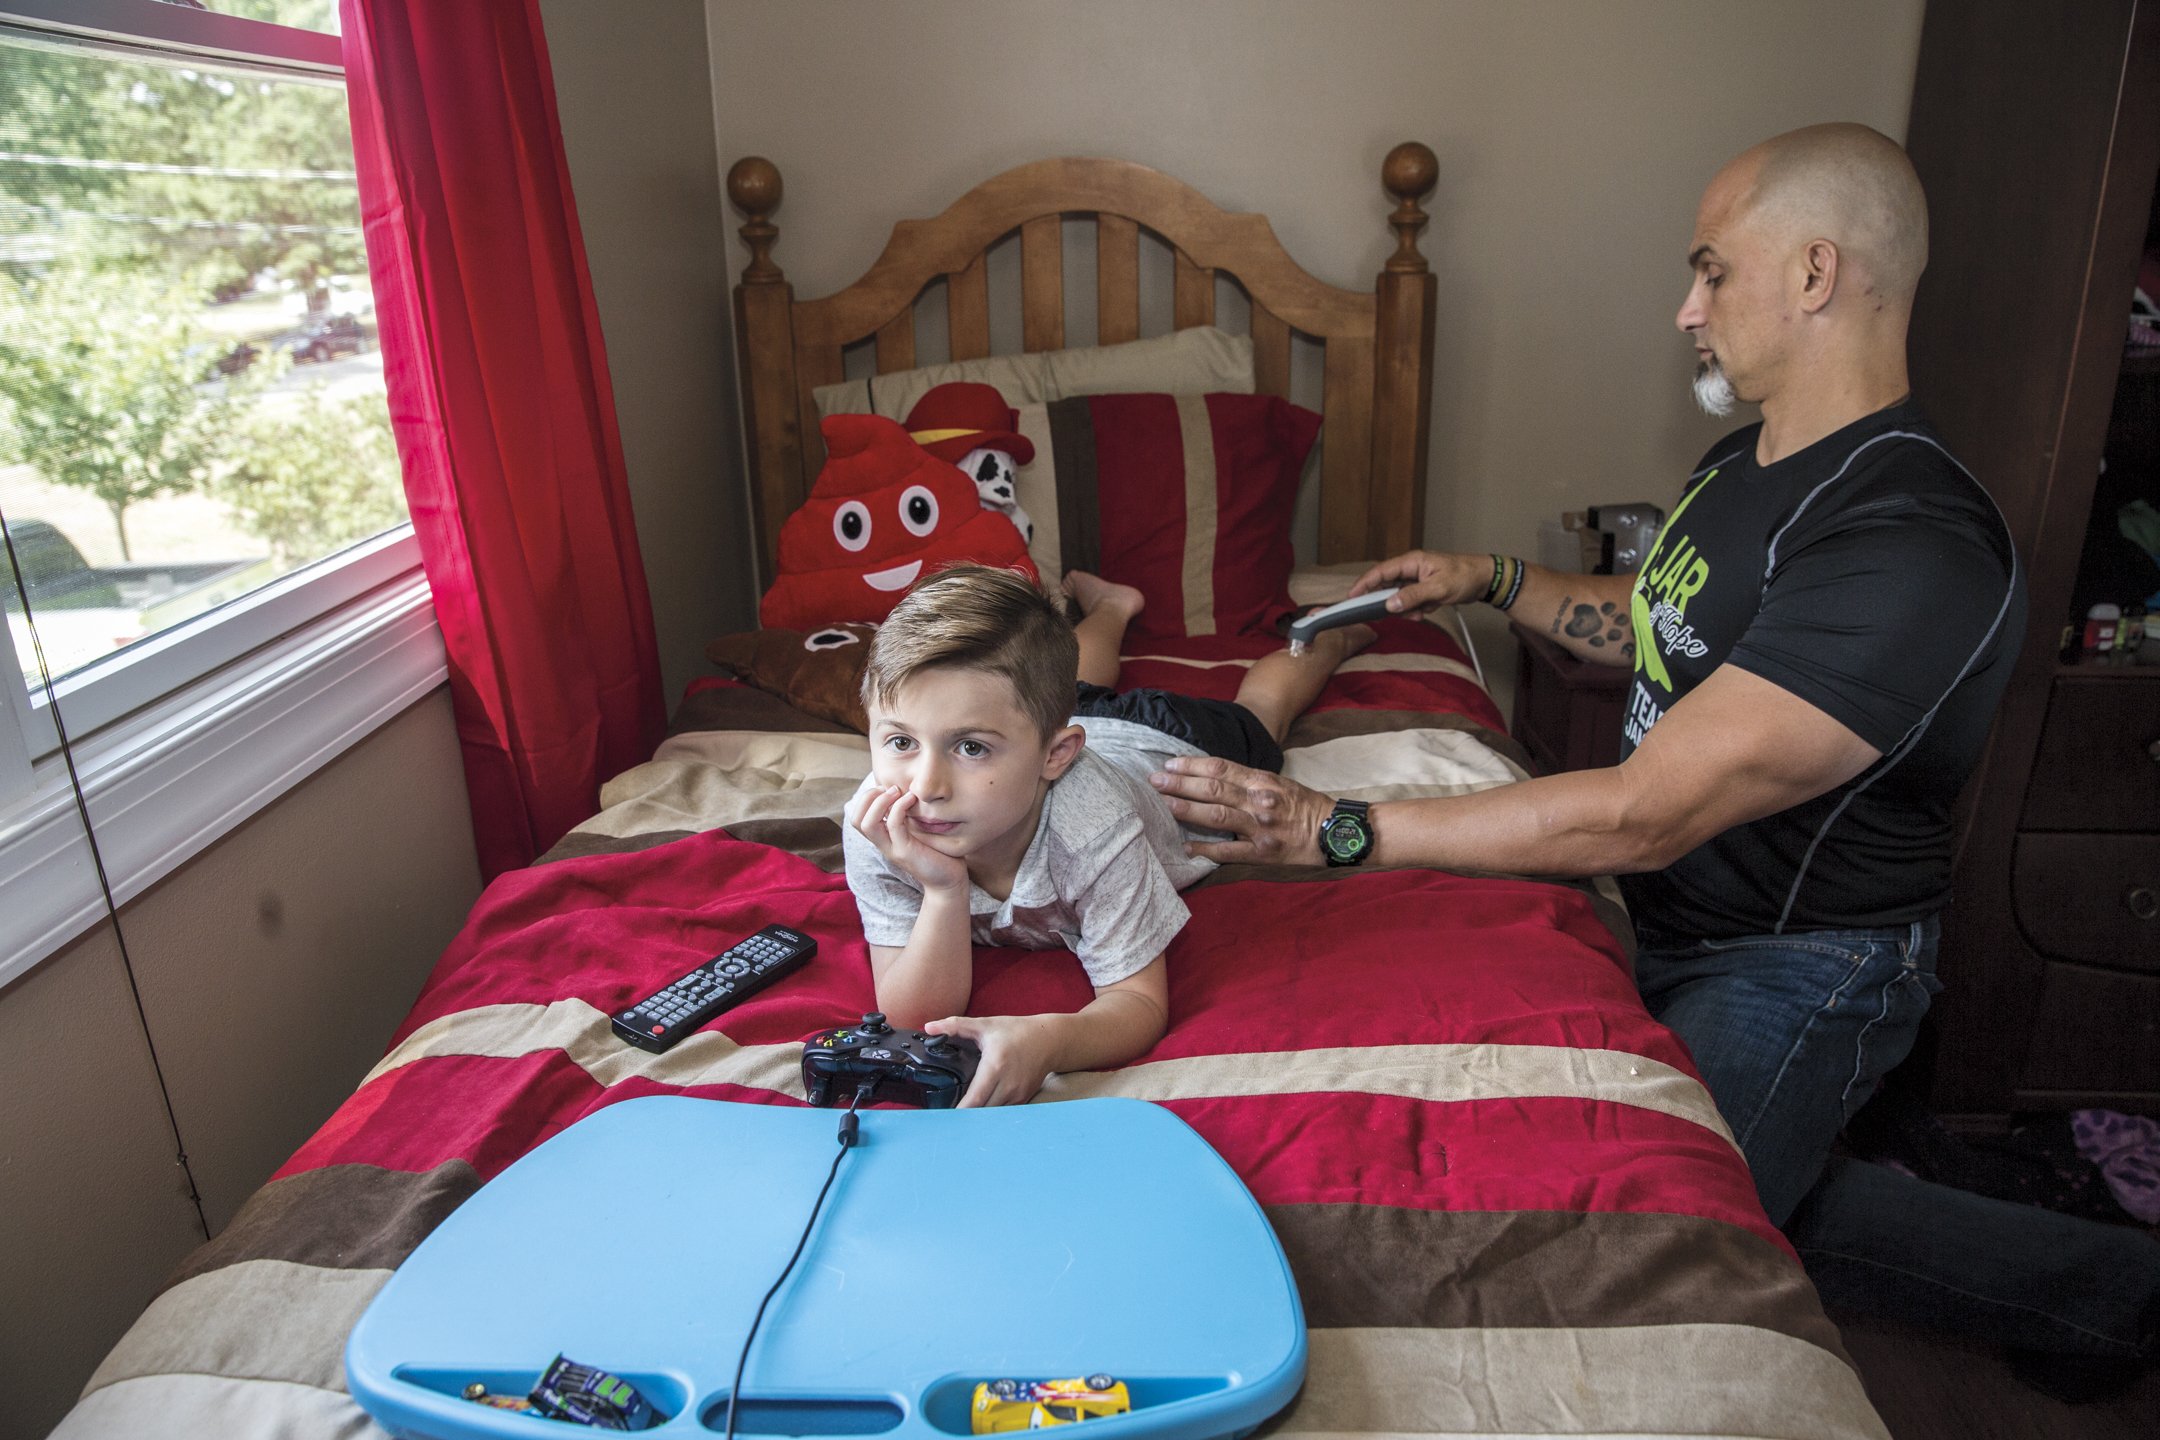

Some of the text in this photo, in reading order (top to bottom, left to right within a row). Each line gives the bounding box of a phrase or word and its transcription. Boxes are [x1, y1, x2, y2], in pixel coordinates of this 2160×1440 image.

[1649, 535, 1709, 625] JAR
[1658, 604, 1709, 657] Hope
[1632, 682, 1664, 732] TEA
